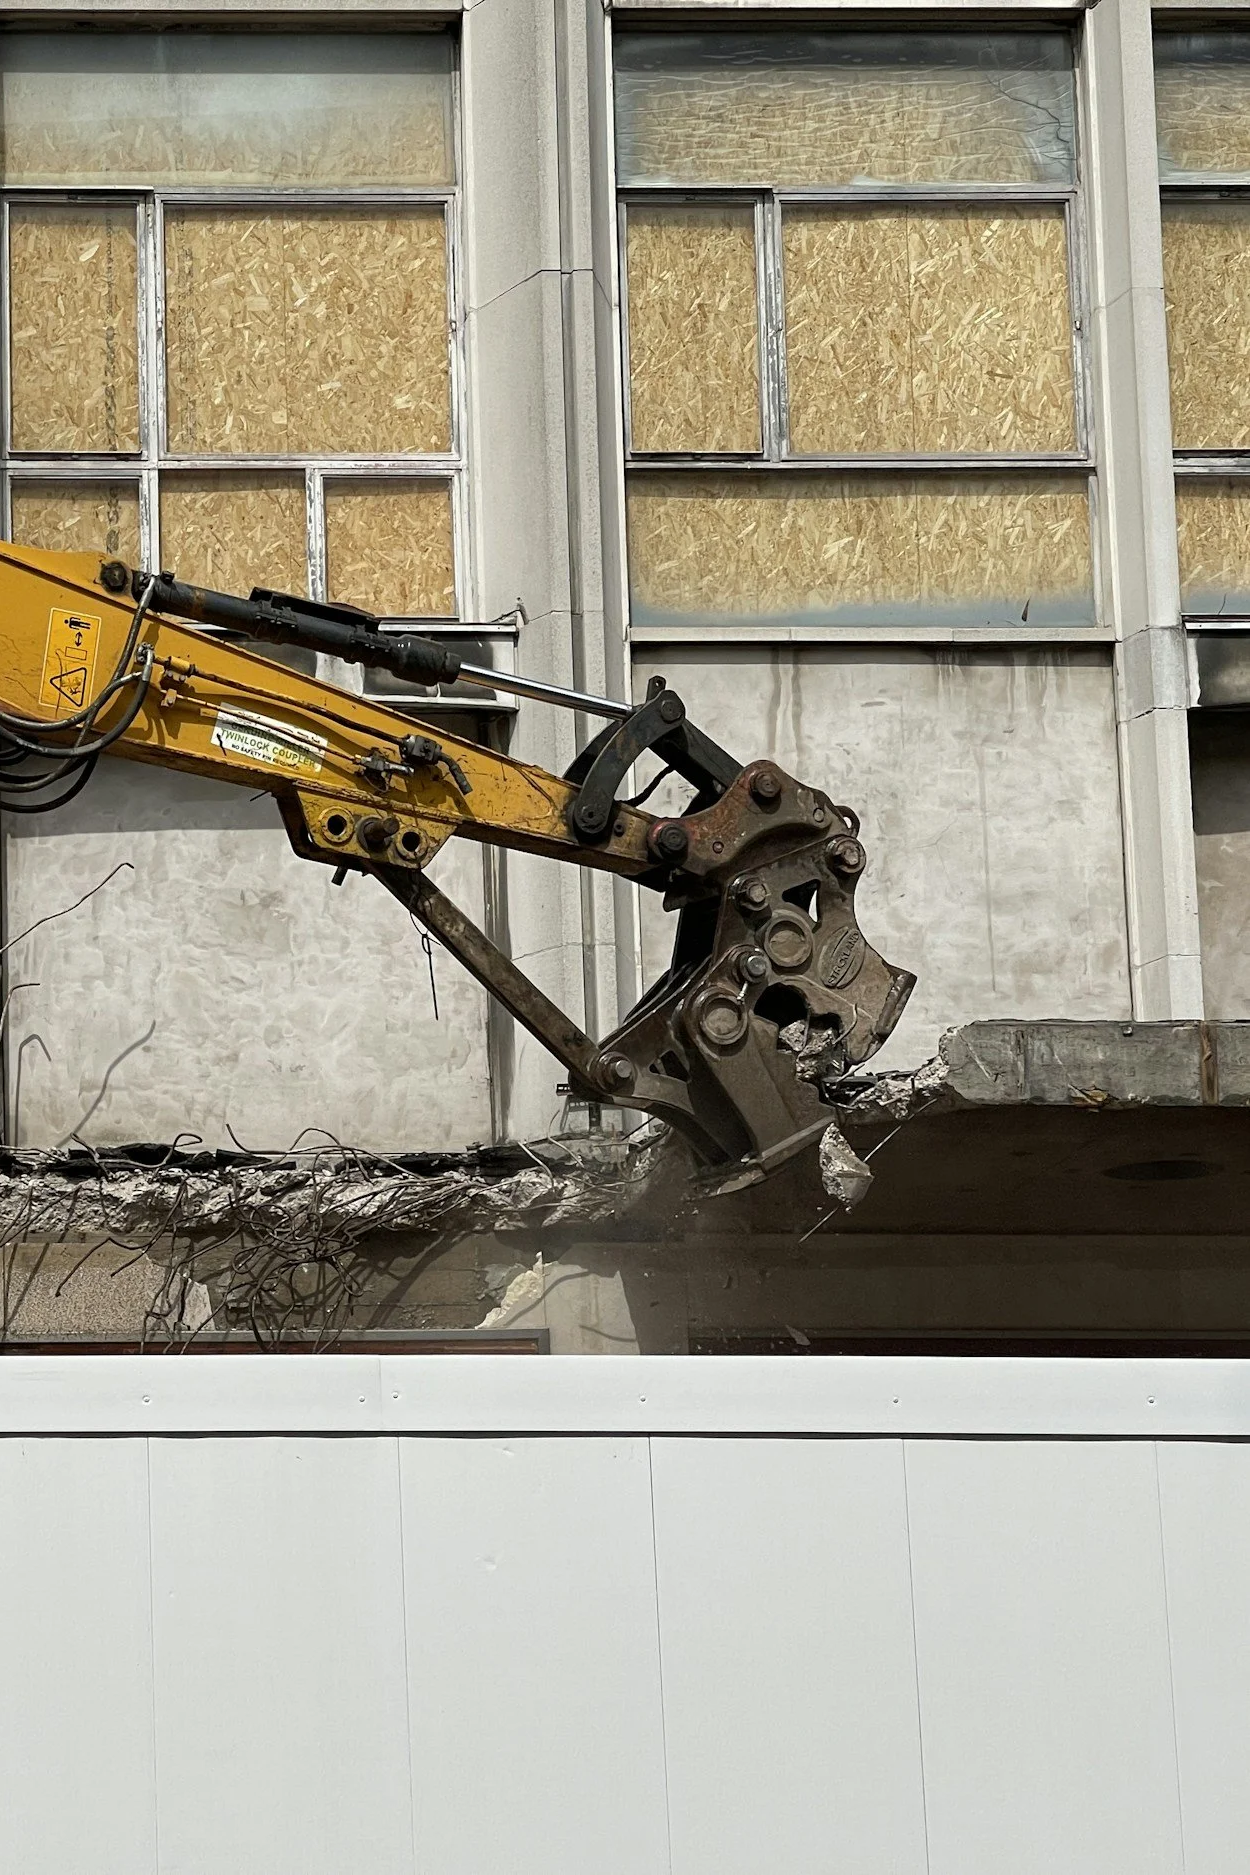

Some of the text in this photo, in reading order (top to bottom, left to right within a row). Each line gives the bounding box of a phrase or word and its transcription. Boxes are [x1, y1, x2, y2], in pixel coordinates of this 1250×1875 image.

[221, 728, 316, 767] TWINLOCK COUPLER
[240, 746, 261, 757] SAFETY
